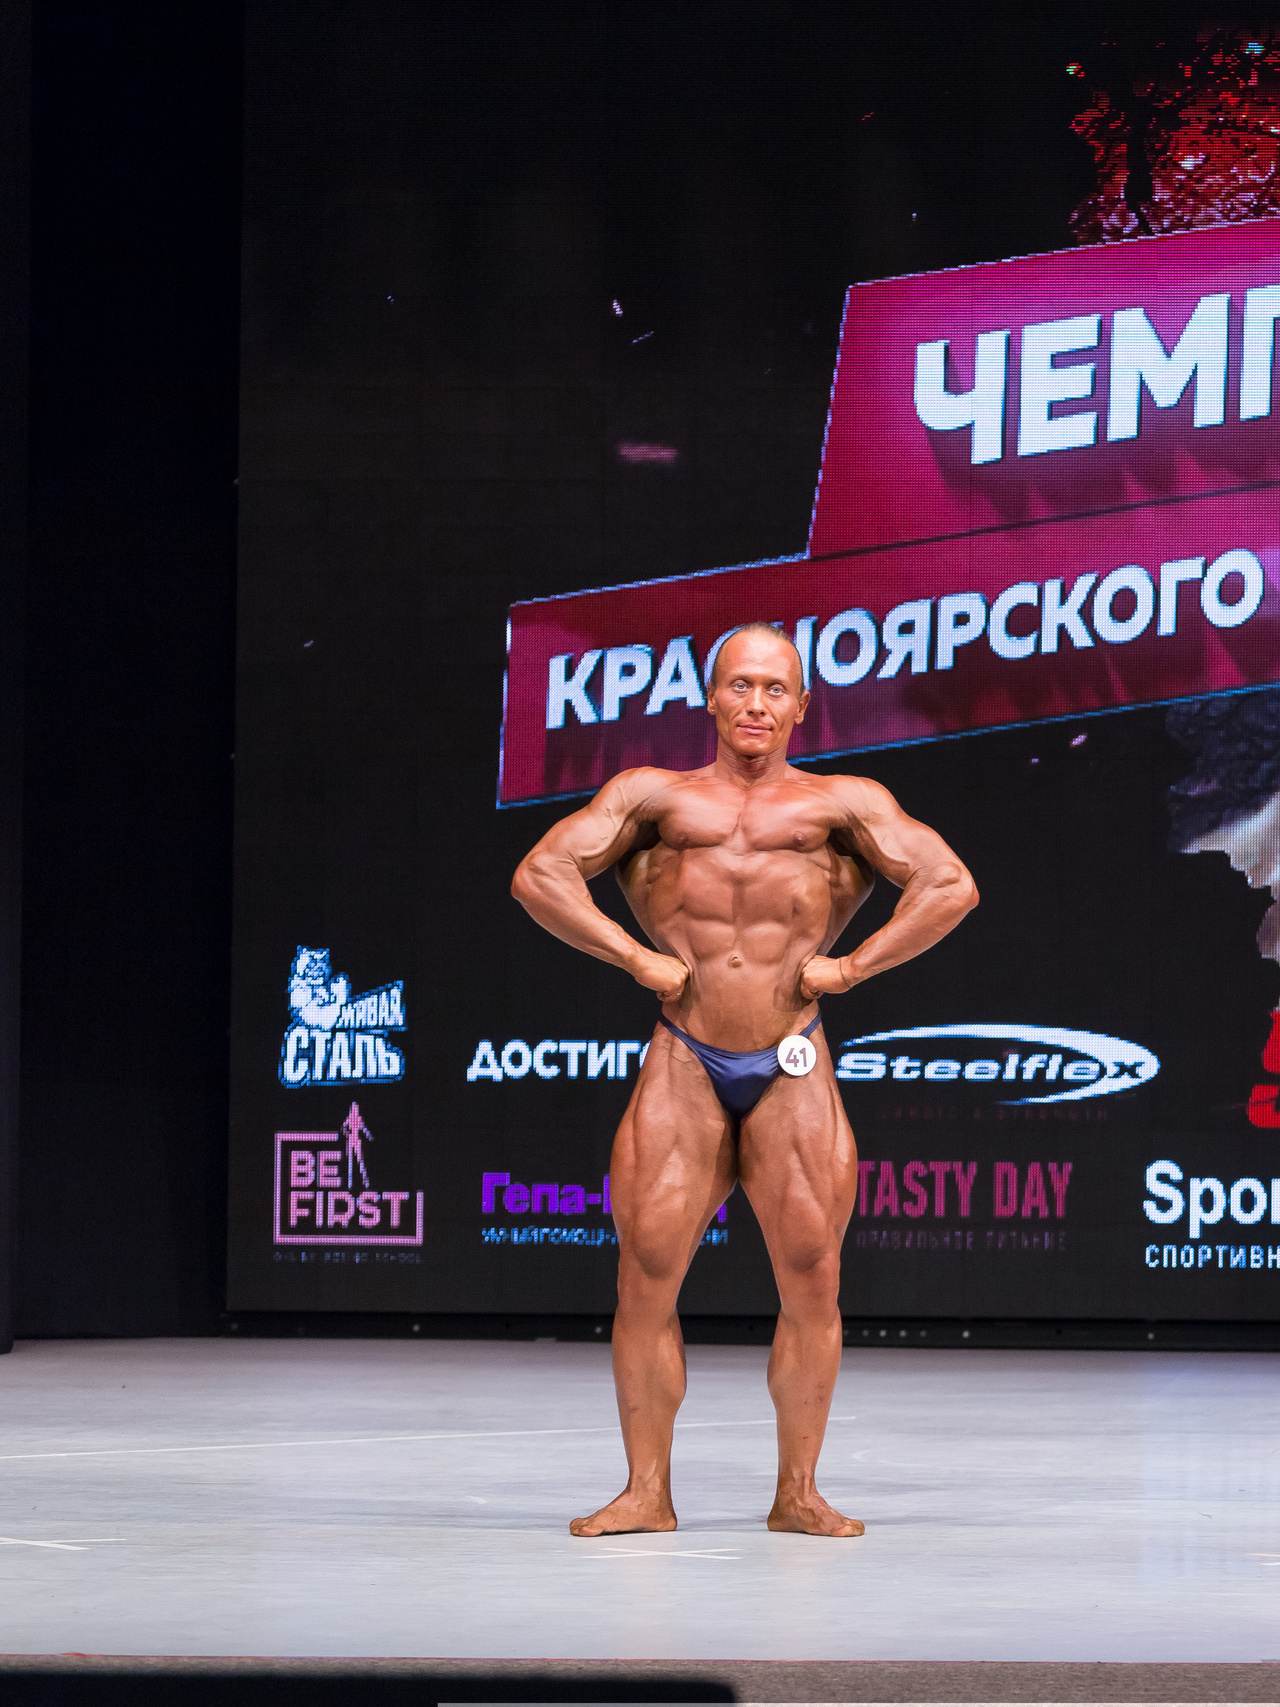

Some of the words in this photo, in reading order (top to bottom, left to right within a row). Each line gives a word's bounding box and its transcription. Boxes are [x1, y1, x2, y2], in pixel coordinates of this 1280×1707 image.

[546, 547, 1265, 729] КРАОЯРСКОГО
[284, 1026, 402, 1084] СТАЛЬ
[467, 1040, 650, 1082] ДОСТИГ
[785, 1047, 807, 1068] 41
[835, 1051, 1147, 1082] Steelflex
[290, 1150, 343, 1189] BE
[857, 1160, 978, 1219] TASTY
[993, 1161, 1074, 1219] DAY
[289, 1191, 410, 1229] FIRST
